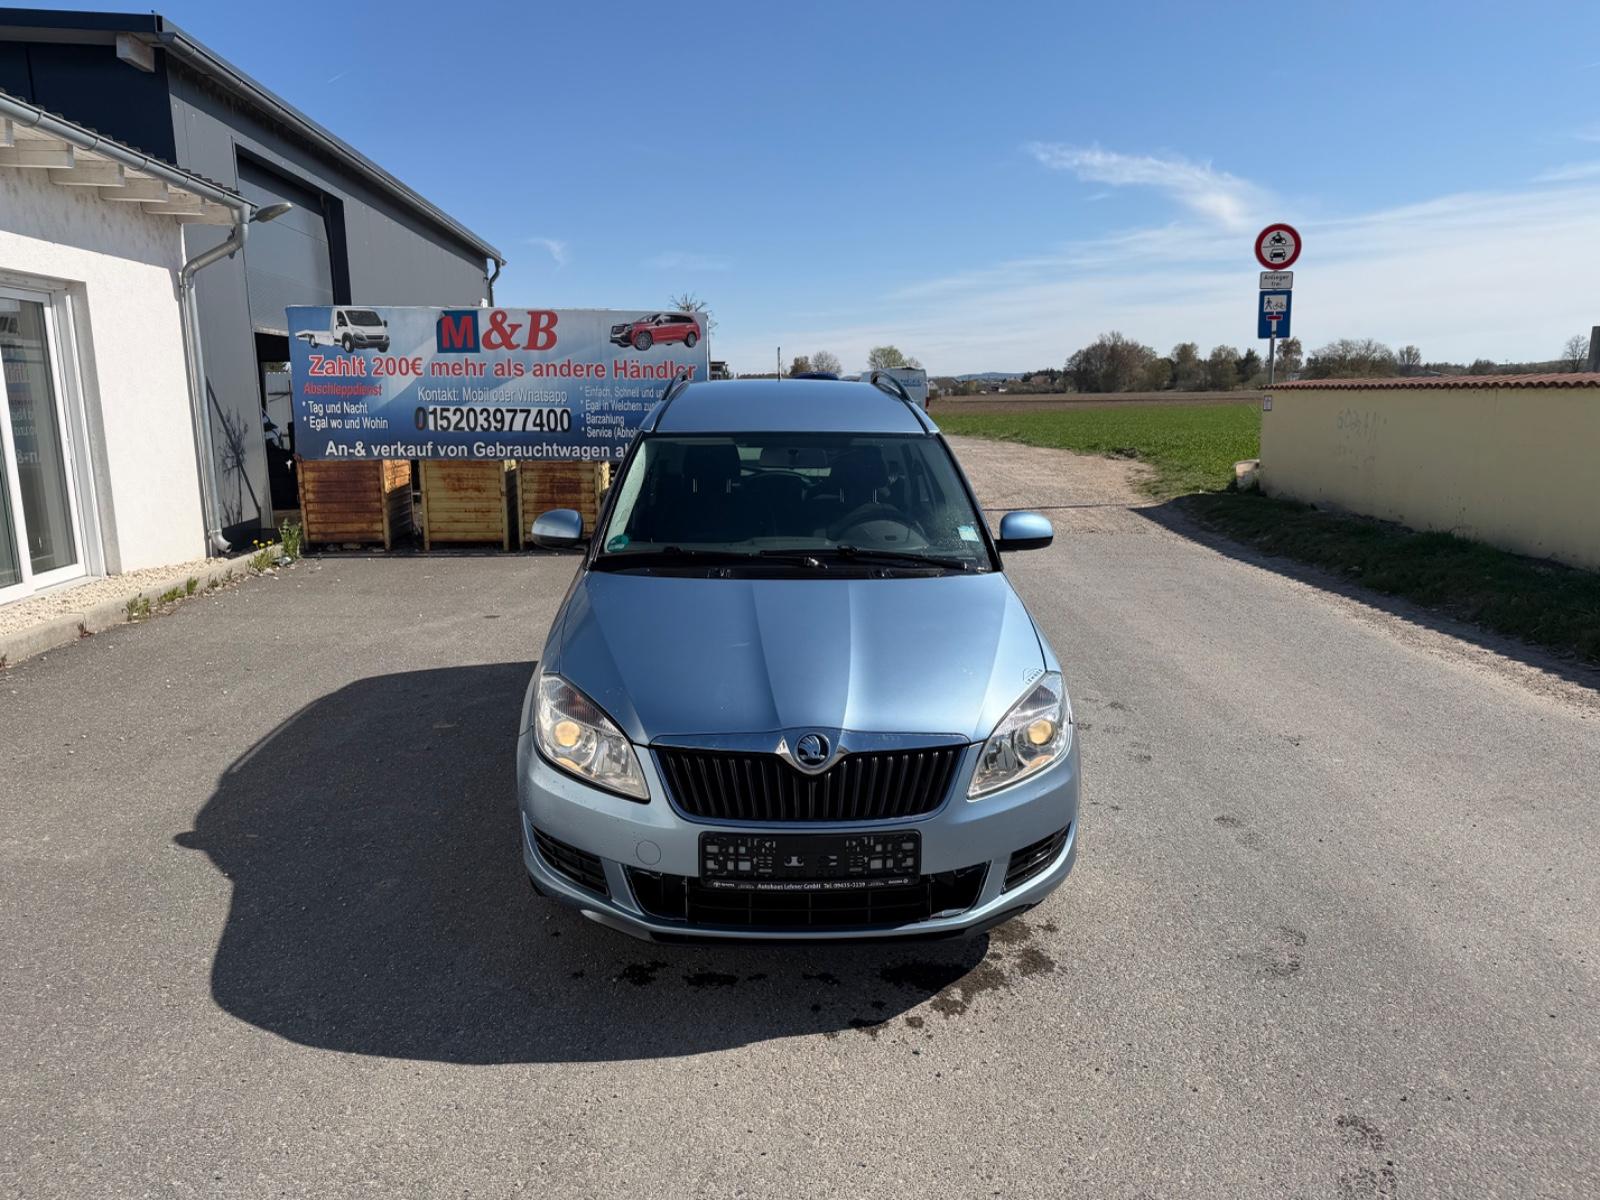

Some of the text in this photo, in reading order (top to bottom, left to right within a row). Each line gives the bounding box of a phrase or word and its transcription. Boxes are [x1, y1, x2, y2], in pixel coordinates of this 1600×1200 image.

[308, 355, 366, 377] Zahlt
[371, 356, 423, 377] 200€
[431, 358, 486, 377] mehr
[494, 358, 525, 378] als
[532, 359, 606, 378] andere
[304, 383, 382, 398] Abschleppdienst
[417, 386, 459, 402] Kontakt:
[492, 388, 514, 402] oder
[518, 388, 568, 405] Whatsapp
[615, 386, 639, 398] Schnell
[641, 387, 654, 398] und
[308, 401, 368, 416] Tag und Nacht
[585, 400, 600, 413] Egal
[602, 400, 610, 411] in
[611, 400, 642, 411] Welchem
[309, 416, 389, 431] Egal wo und Wohin
[415, 406, 572, 432] 015203977400
[585, 413, 625, 426] Barzahlung
[586, 427, 612, 438] Service
[325, 441, 630, 460] An-& verkauf von Gebrauchtwagen al
